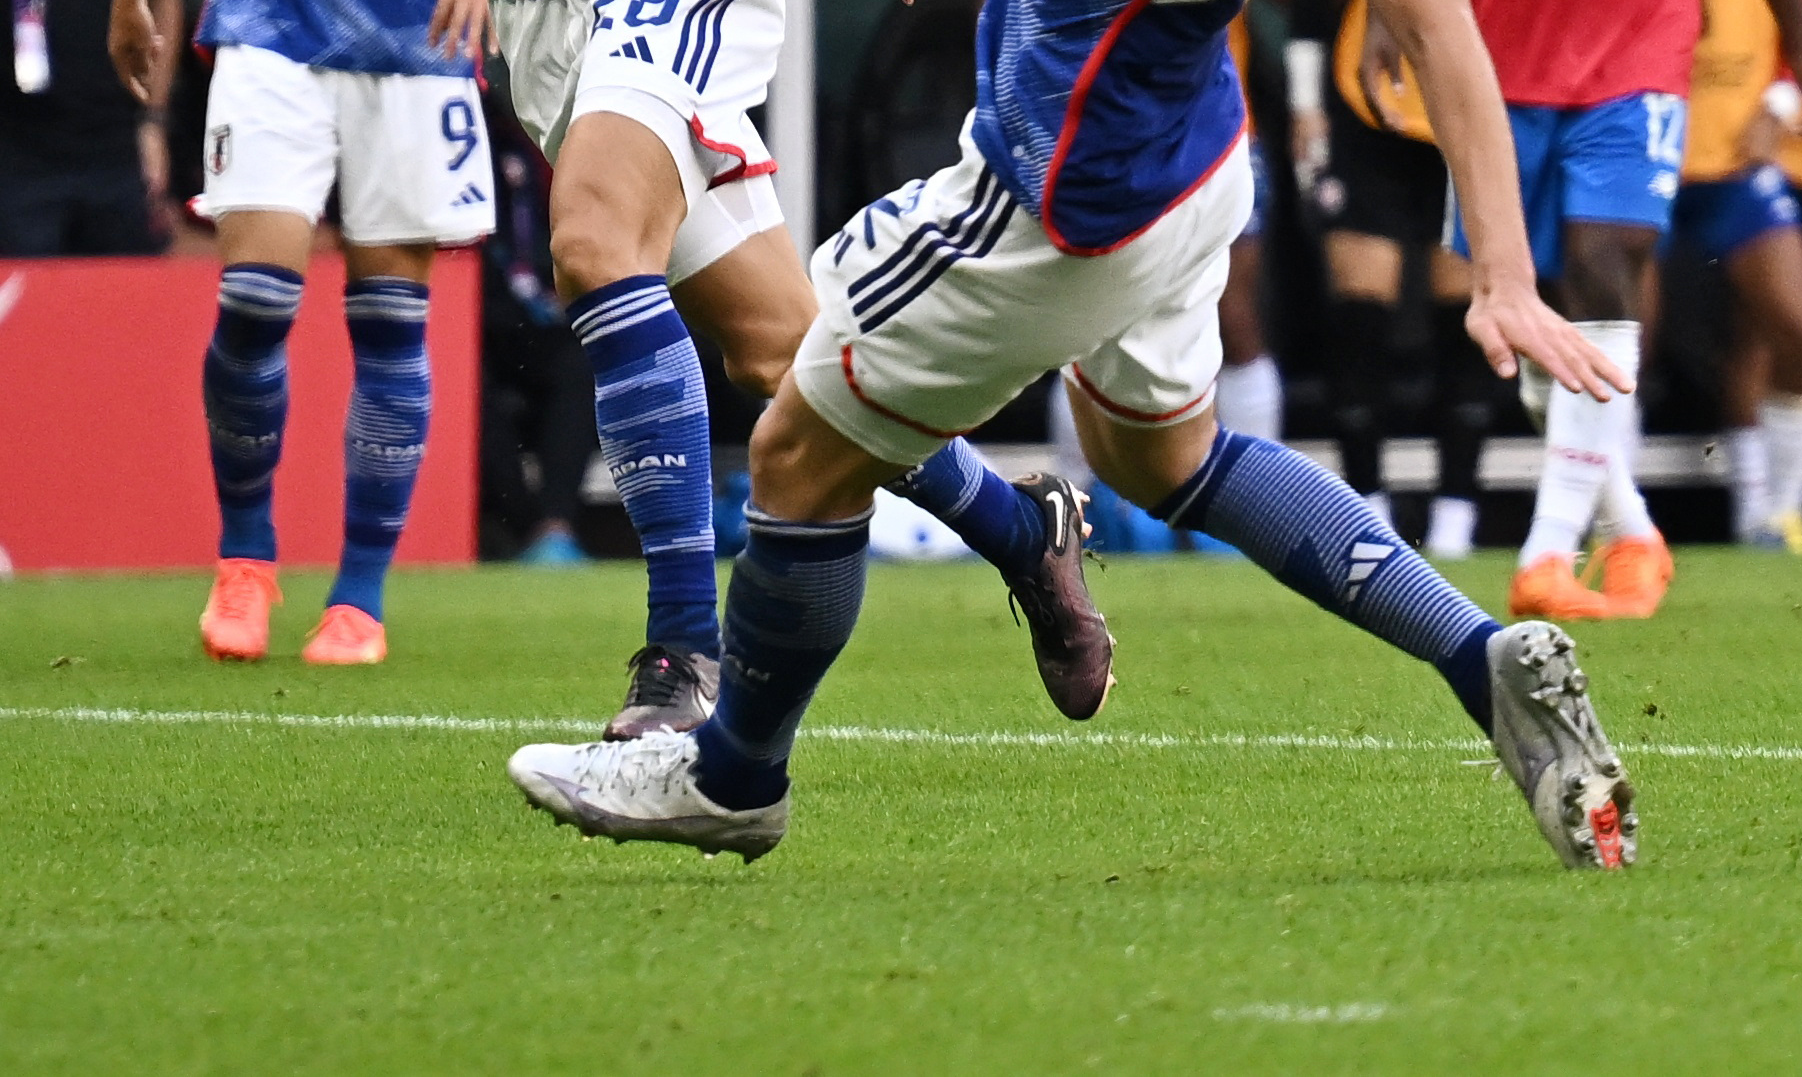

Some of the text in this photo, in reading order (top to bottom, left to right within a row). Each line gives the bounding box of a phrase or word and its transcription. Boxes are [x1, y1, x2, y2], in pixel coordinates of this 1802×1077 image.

[441, 96, 478, 172] 9
[1640, 91, 1687, 163] 12
[611, 453, 686, 480] APAN
